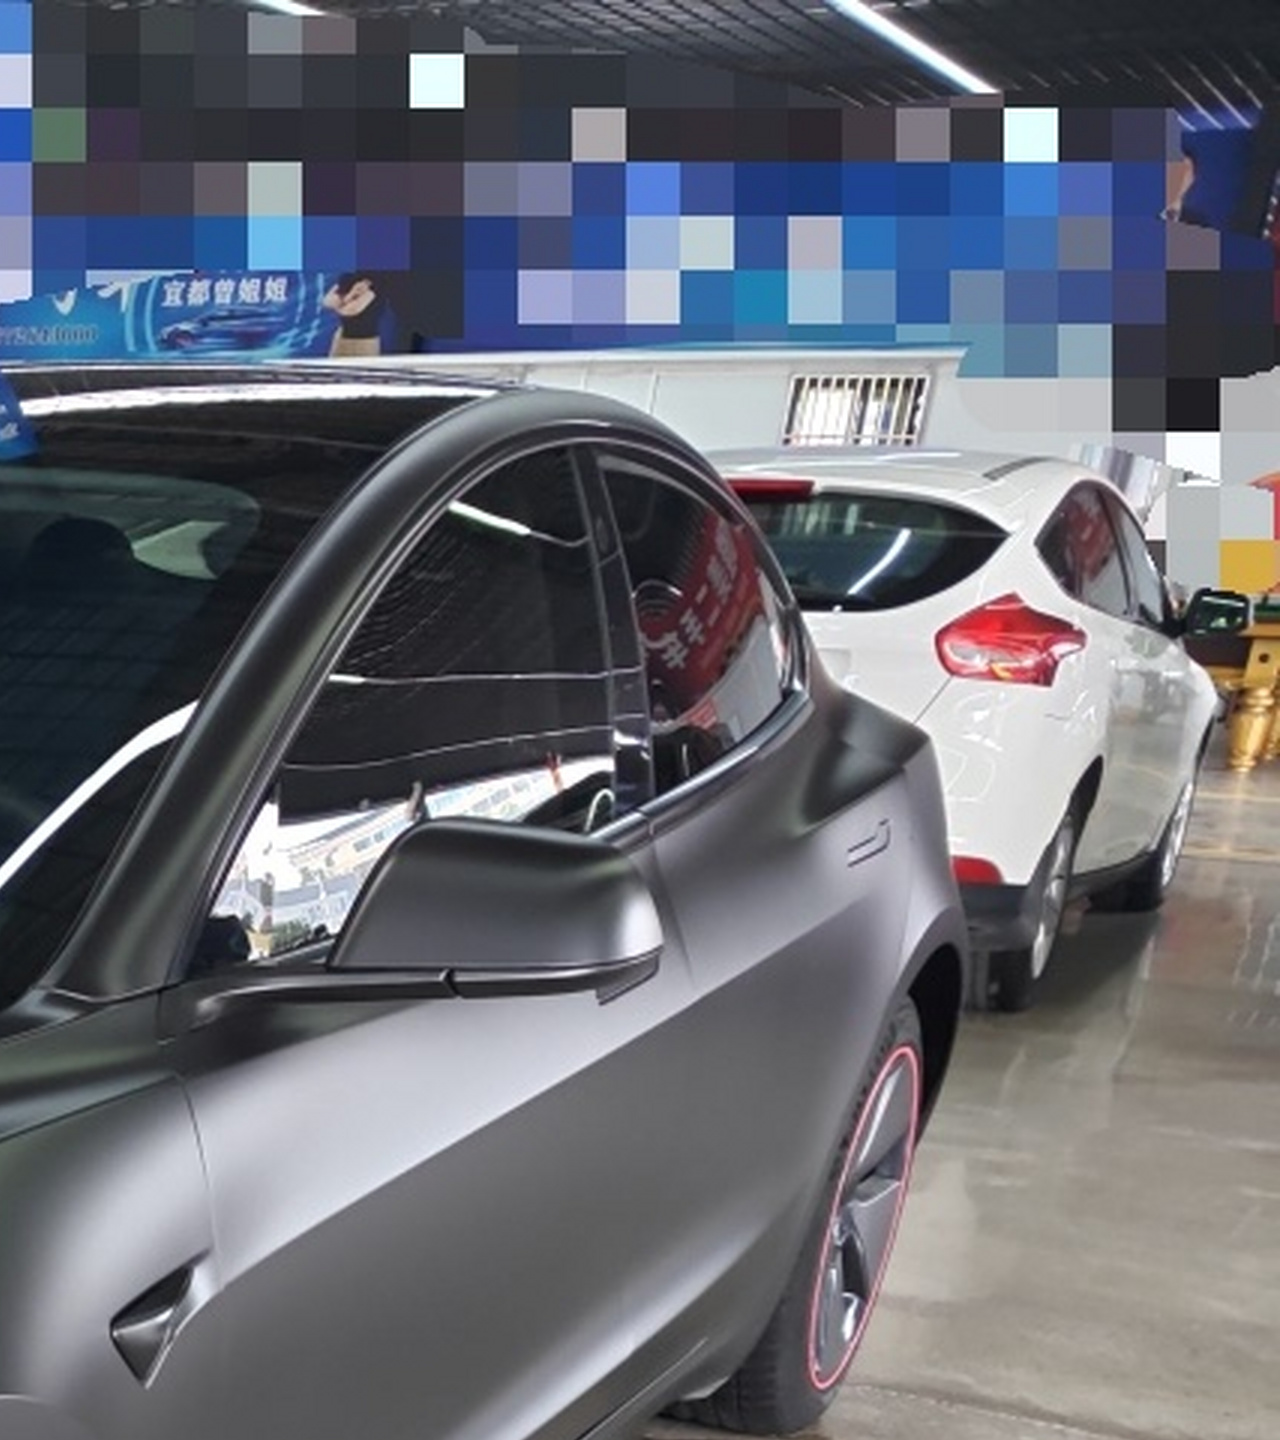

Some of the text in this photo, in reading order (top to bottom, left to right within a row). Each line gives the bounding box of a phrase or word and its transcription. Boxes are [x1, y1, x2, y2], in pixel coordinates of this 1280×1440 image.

[161, 276, 287, 306] 宜都曾姐姐
